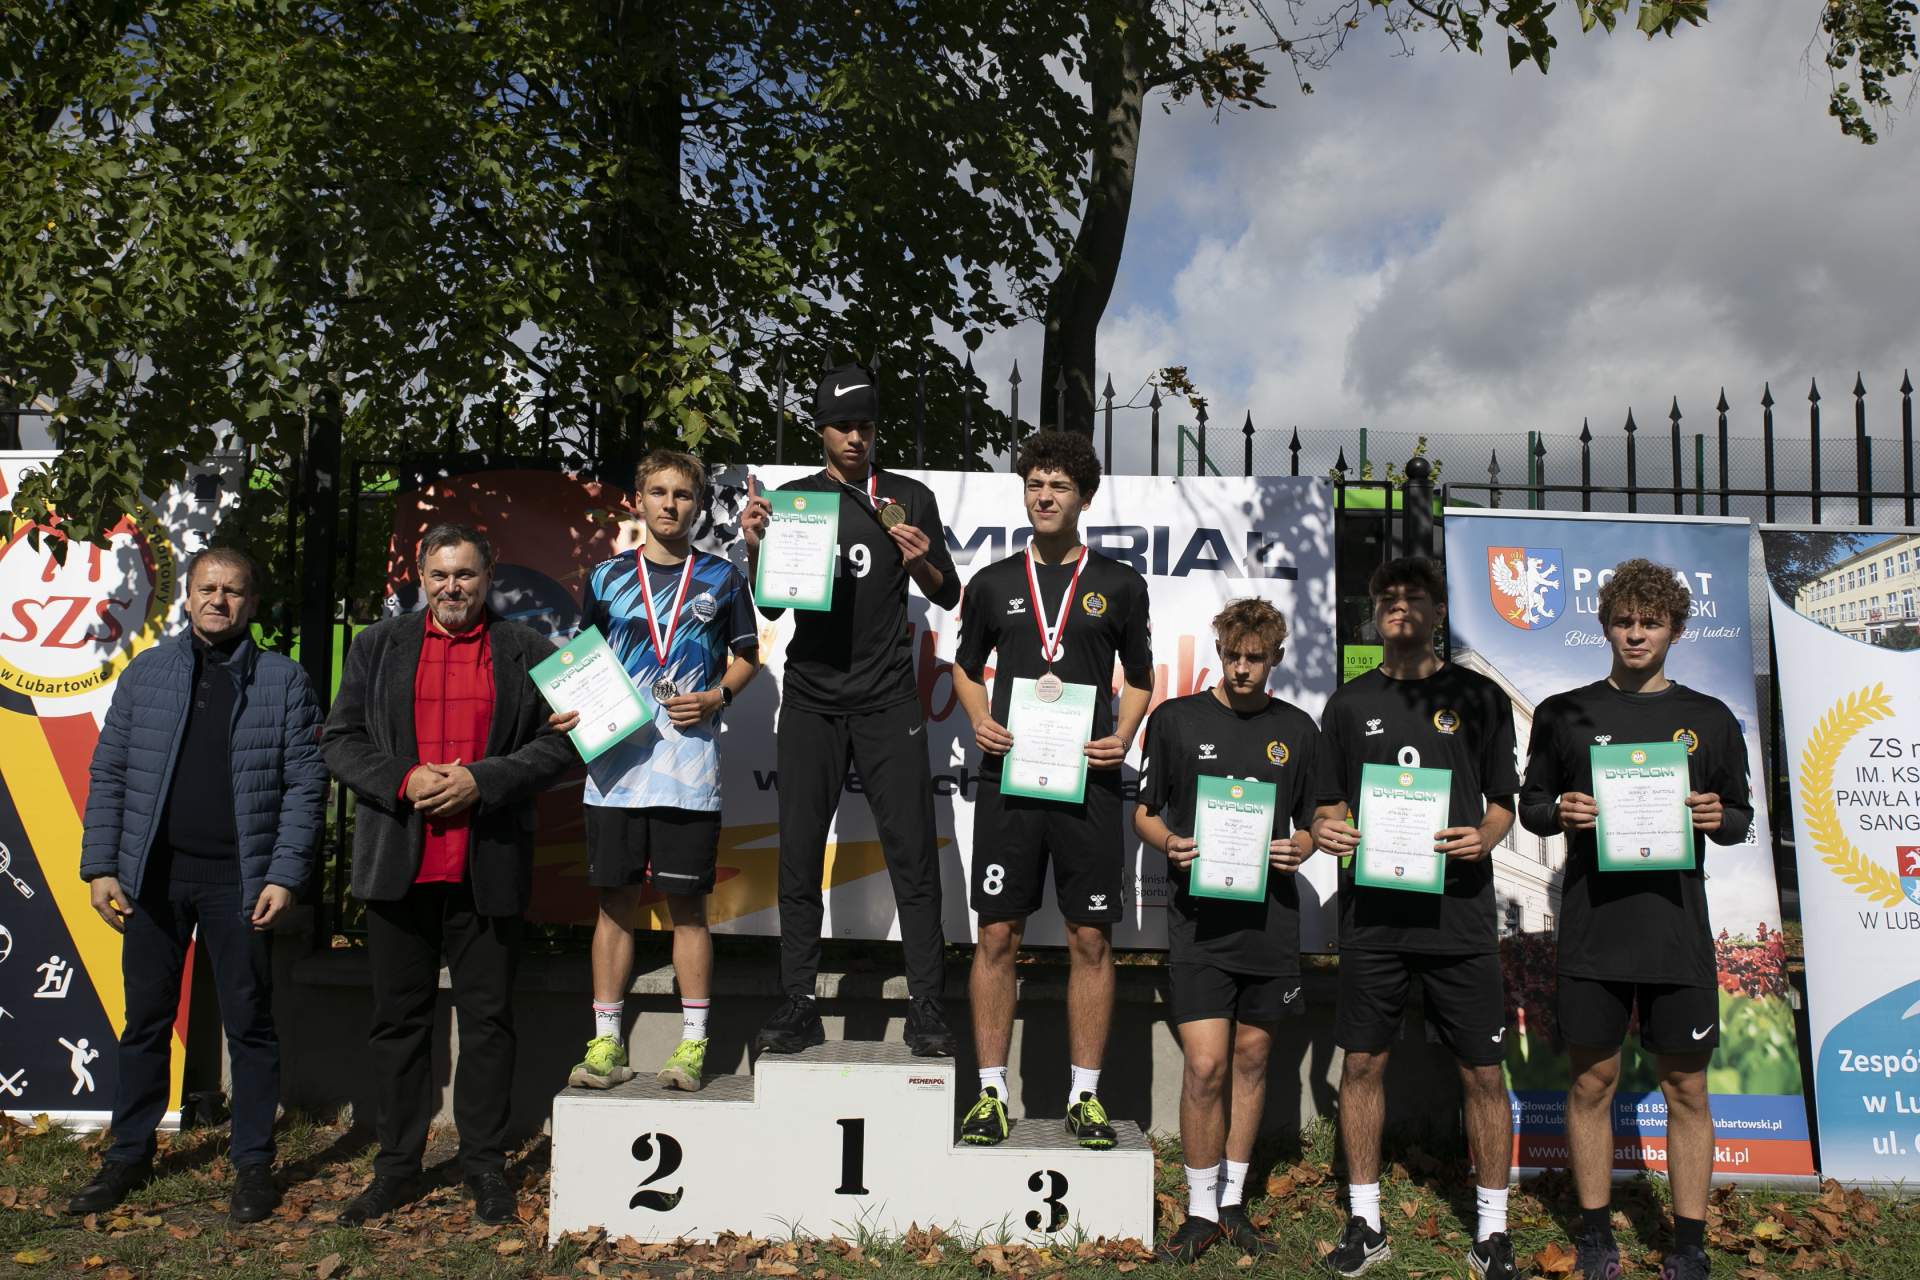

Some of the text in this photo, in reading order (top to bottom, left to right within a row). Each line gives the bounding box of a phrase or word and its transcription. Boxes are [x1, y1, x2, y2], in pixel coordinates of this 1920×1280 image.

[772, 513, 827, 525] DYPLOM
[1, 596, 132, 648] SZS
[1703, 626, 1741, 638] ludzi!
[550, 650, 602, 690] DYPLOM
[1, 668, 108, 694] w Lubartowie
[1869, 738, 1902, 758] ZS
[1605, 767, 1675, 780] DYPLOM
[1856, 766, 1885, 783] IM.
[1372, 787, 1437, 803] DYPLOM
[1837, 790, 1910, 806] PAWŁA
[1208, 800, 1263, 815] DYPLOM
[983, 863, 1006, 895] 8
[1858, 912, 1878, 929] W
[1838, 1049, 1920, 1078] Zespó
[1637, 1103, 1650, 1113] 81
[1862, 1095, 1887, 1113] w
[1872, 1130, 1906, 1155] ul.
[835, 1118, 870, 1195] 1
[629, 1132, 684, 1212] 2
[1024, 1170, 1069, 1233] 3
